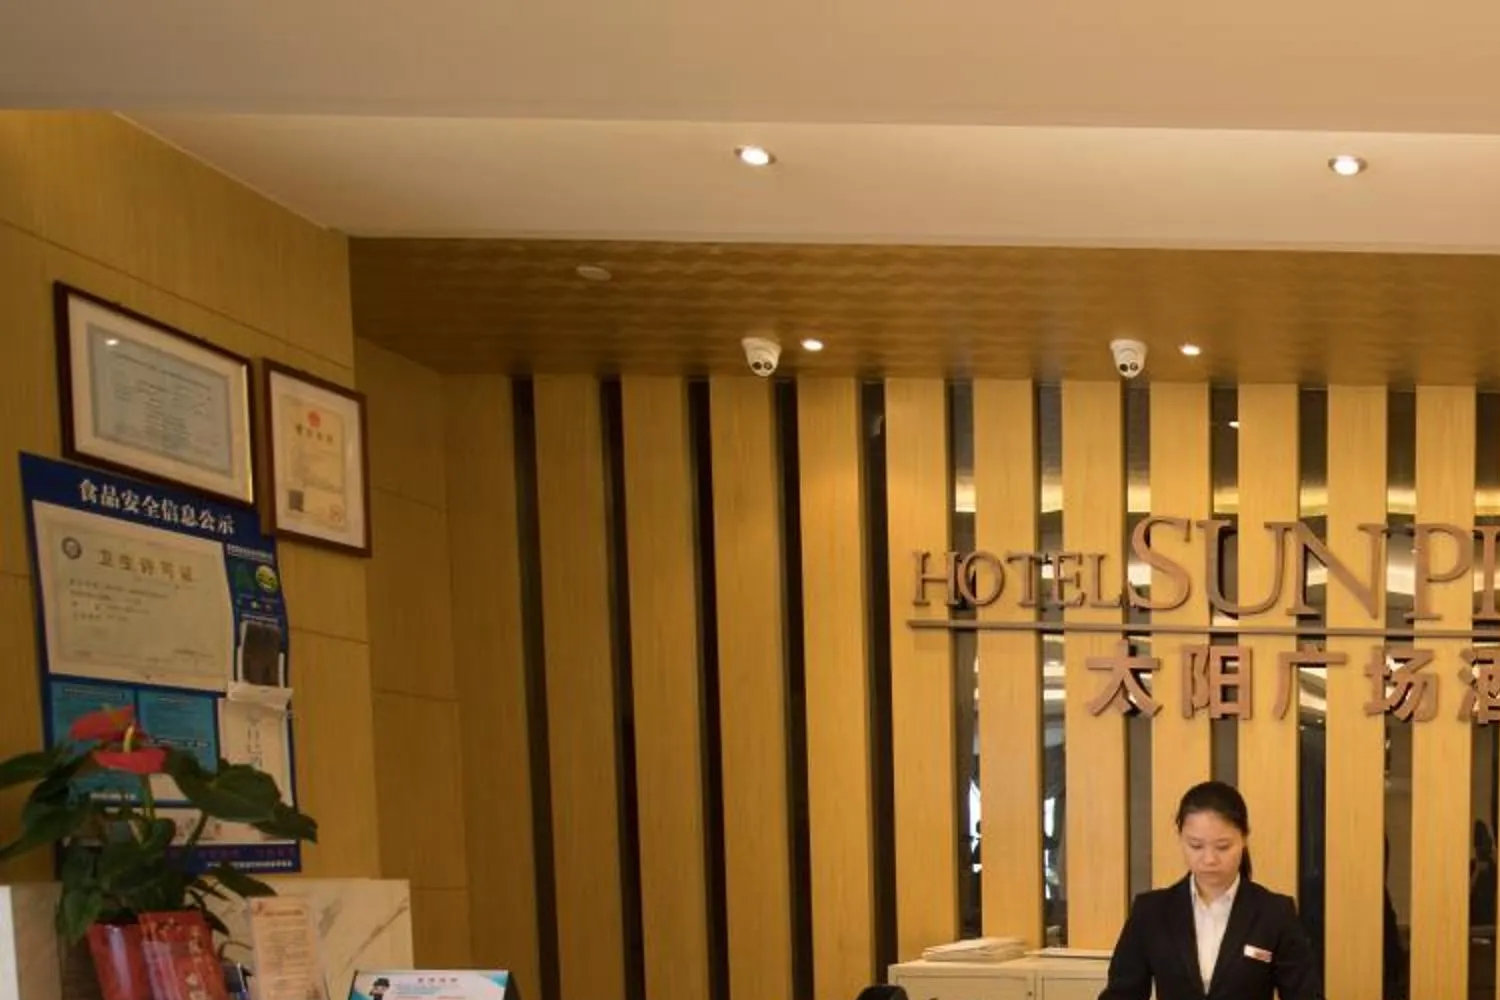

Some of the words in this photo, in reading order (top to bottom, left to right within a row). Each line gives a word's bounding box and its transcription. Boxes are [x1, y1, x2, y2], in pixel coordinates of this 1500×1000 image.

[79, 479, 237, 535] 食品安全信息公示
[912, 550, 1124, 609] HOTEL
